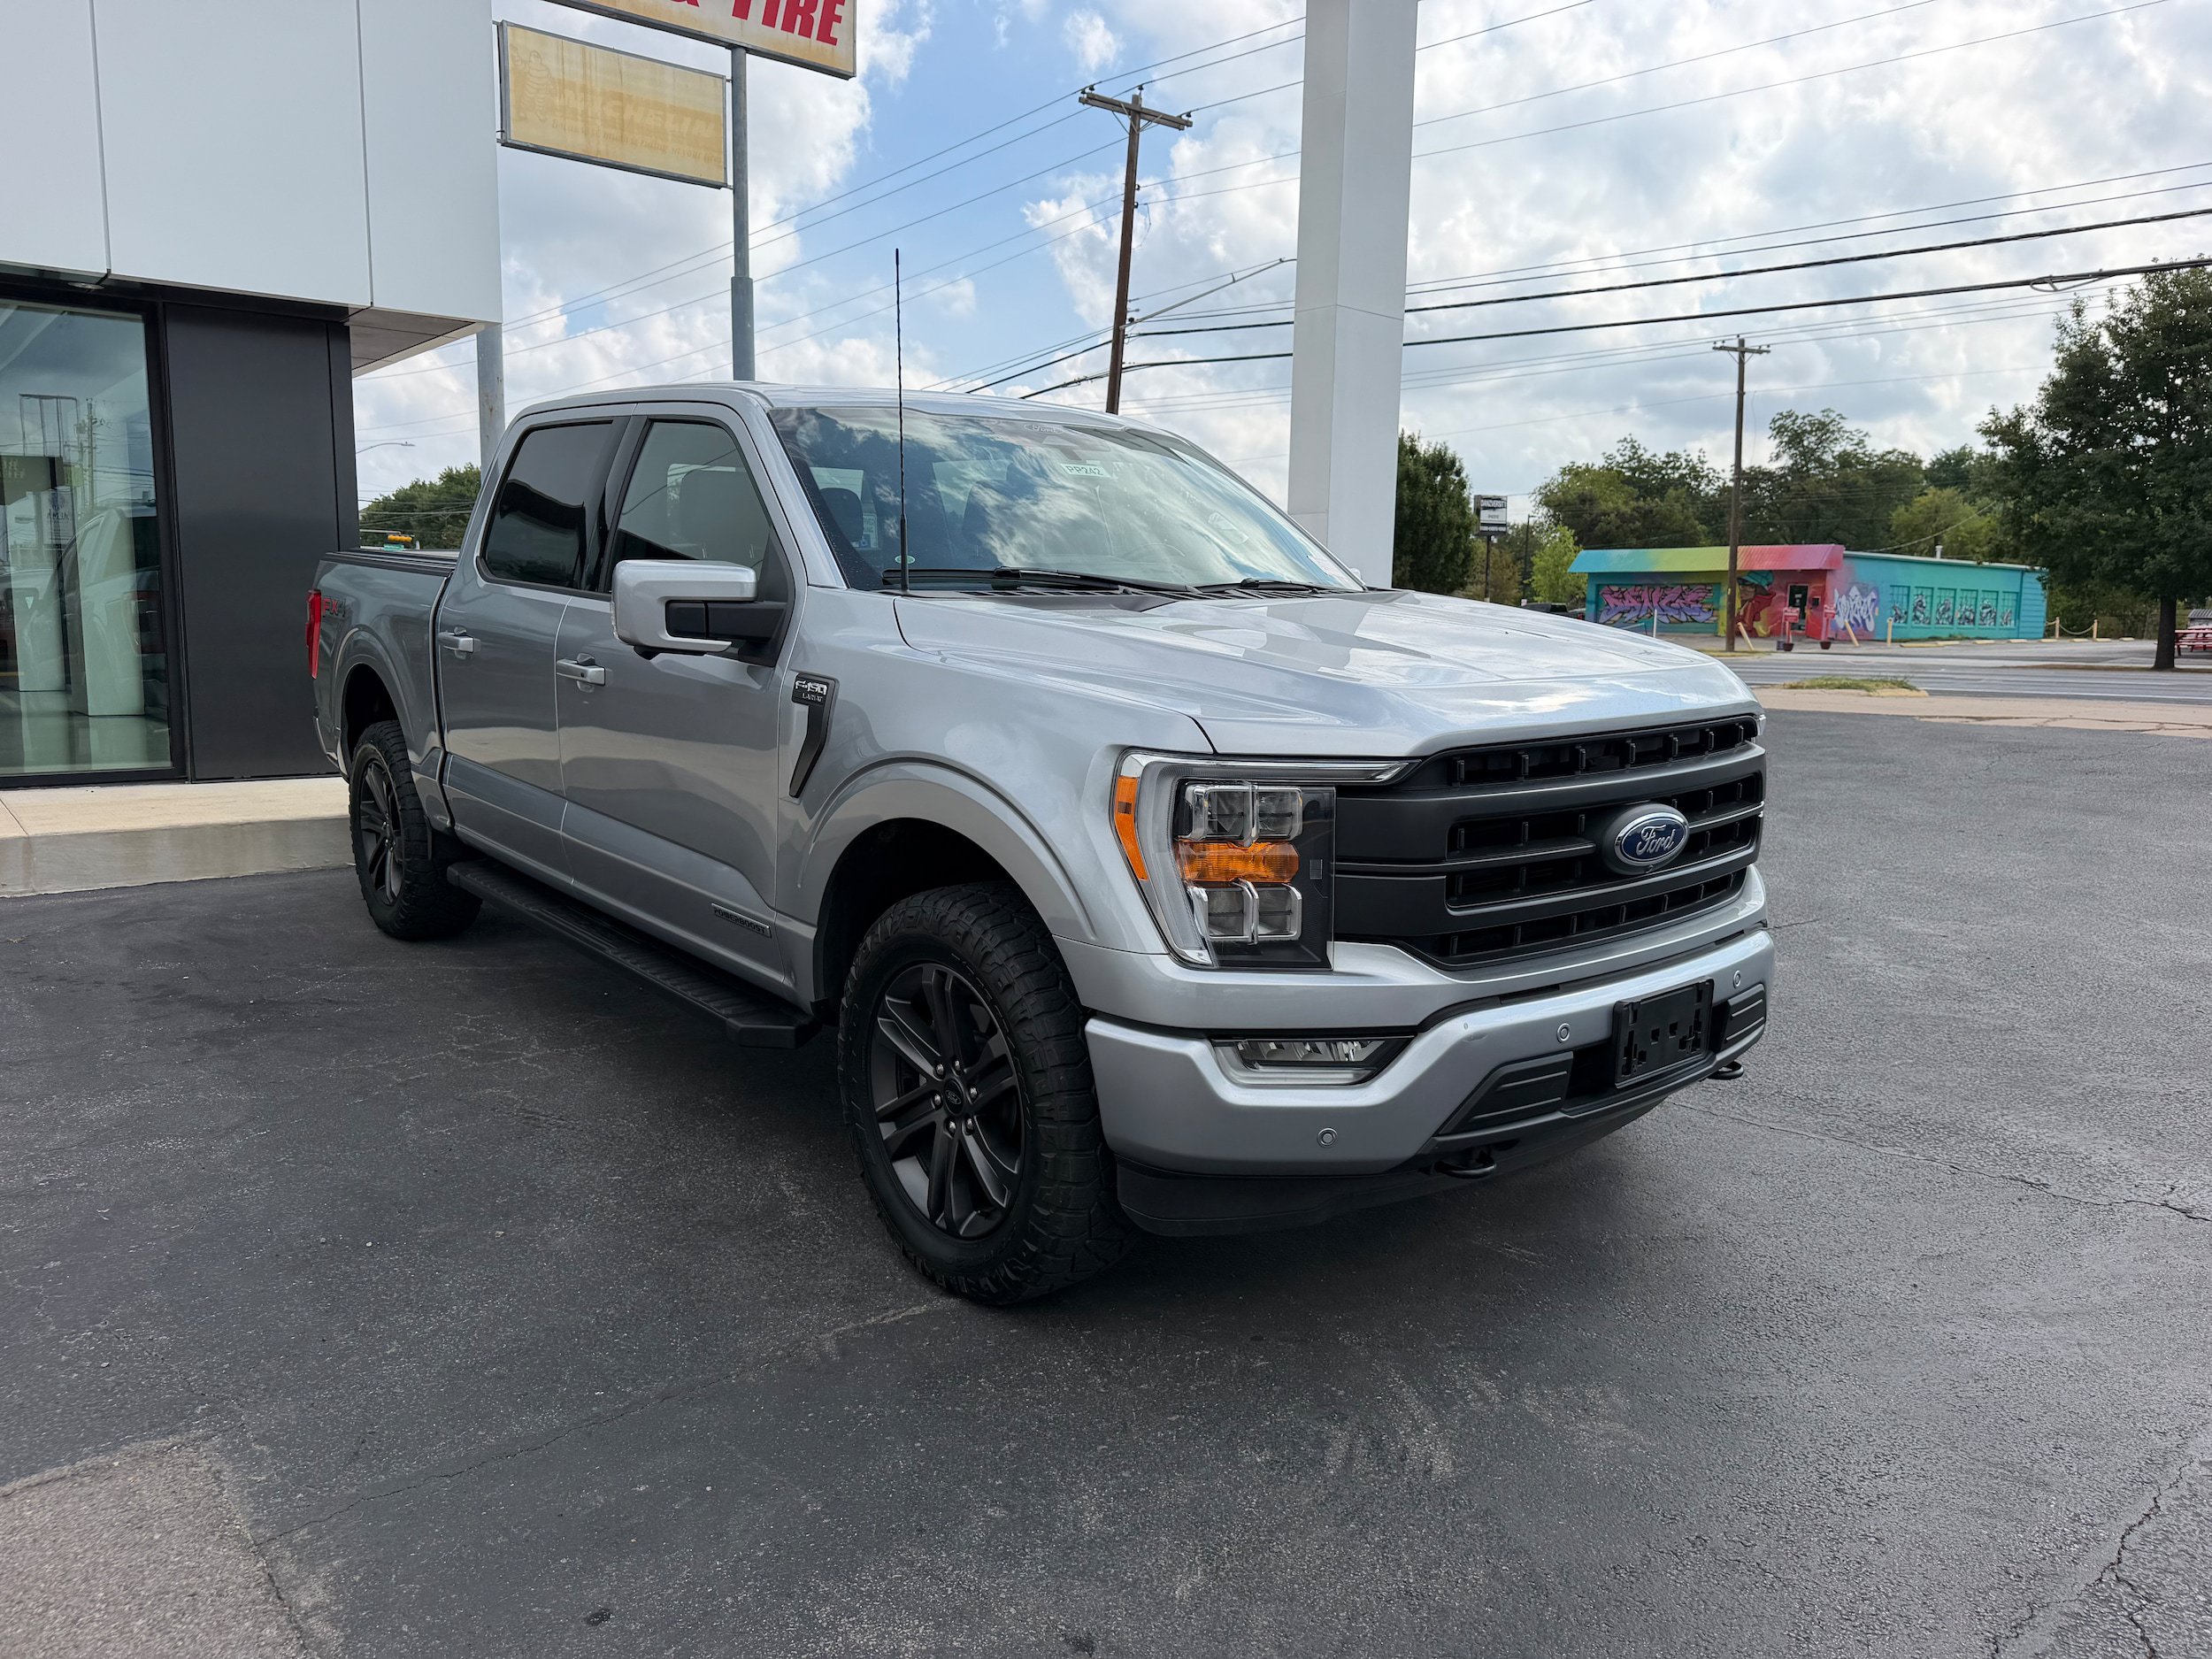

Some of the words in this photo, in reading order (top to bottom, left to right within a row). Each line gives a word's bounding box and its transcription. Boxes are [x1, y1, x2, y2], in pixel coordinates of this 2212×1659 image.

[1065, 465, 1104, 475] PP242
[323, 597, 346, 617] FX4
[795, 680, 827, 695] F-150
[1636, 824, 1677, 856] Ford
